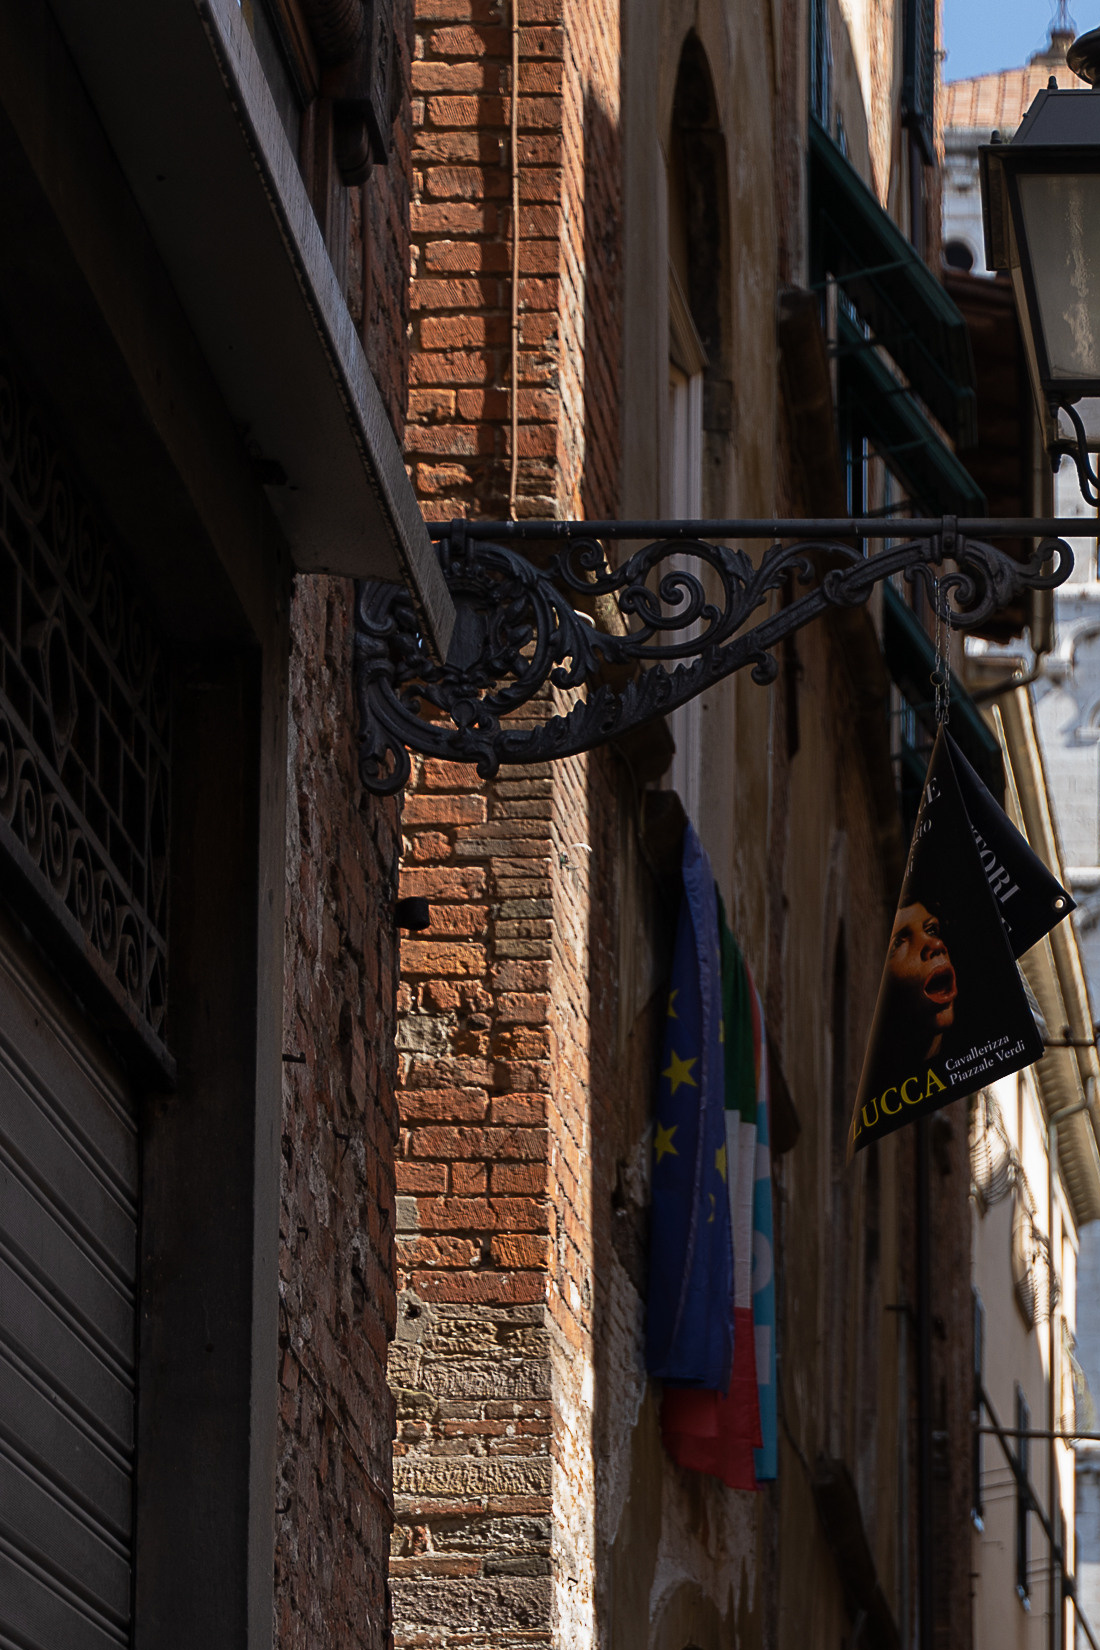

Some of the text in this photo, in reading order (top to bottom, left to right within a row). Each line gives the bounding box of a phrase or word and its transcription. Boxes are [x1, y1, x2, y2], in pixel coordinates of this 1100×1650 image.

[944, 1034, 1010, 1071] Cavallerizza
[948, 1040, 1026, 1086] Piazzale Verdi
